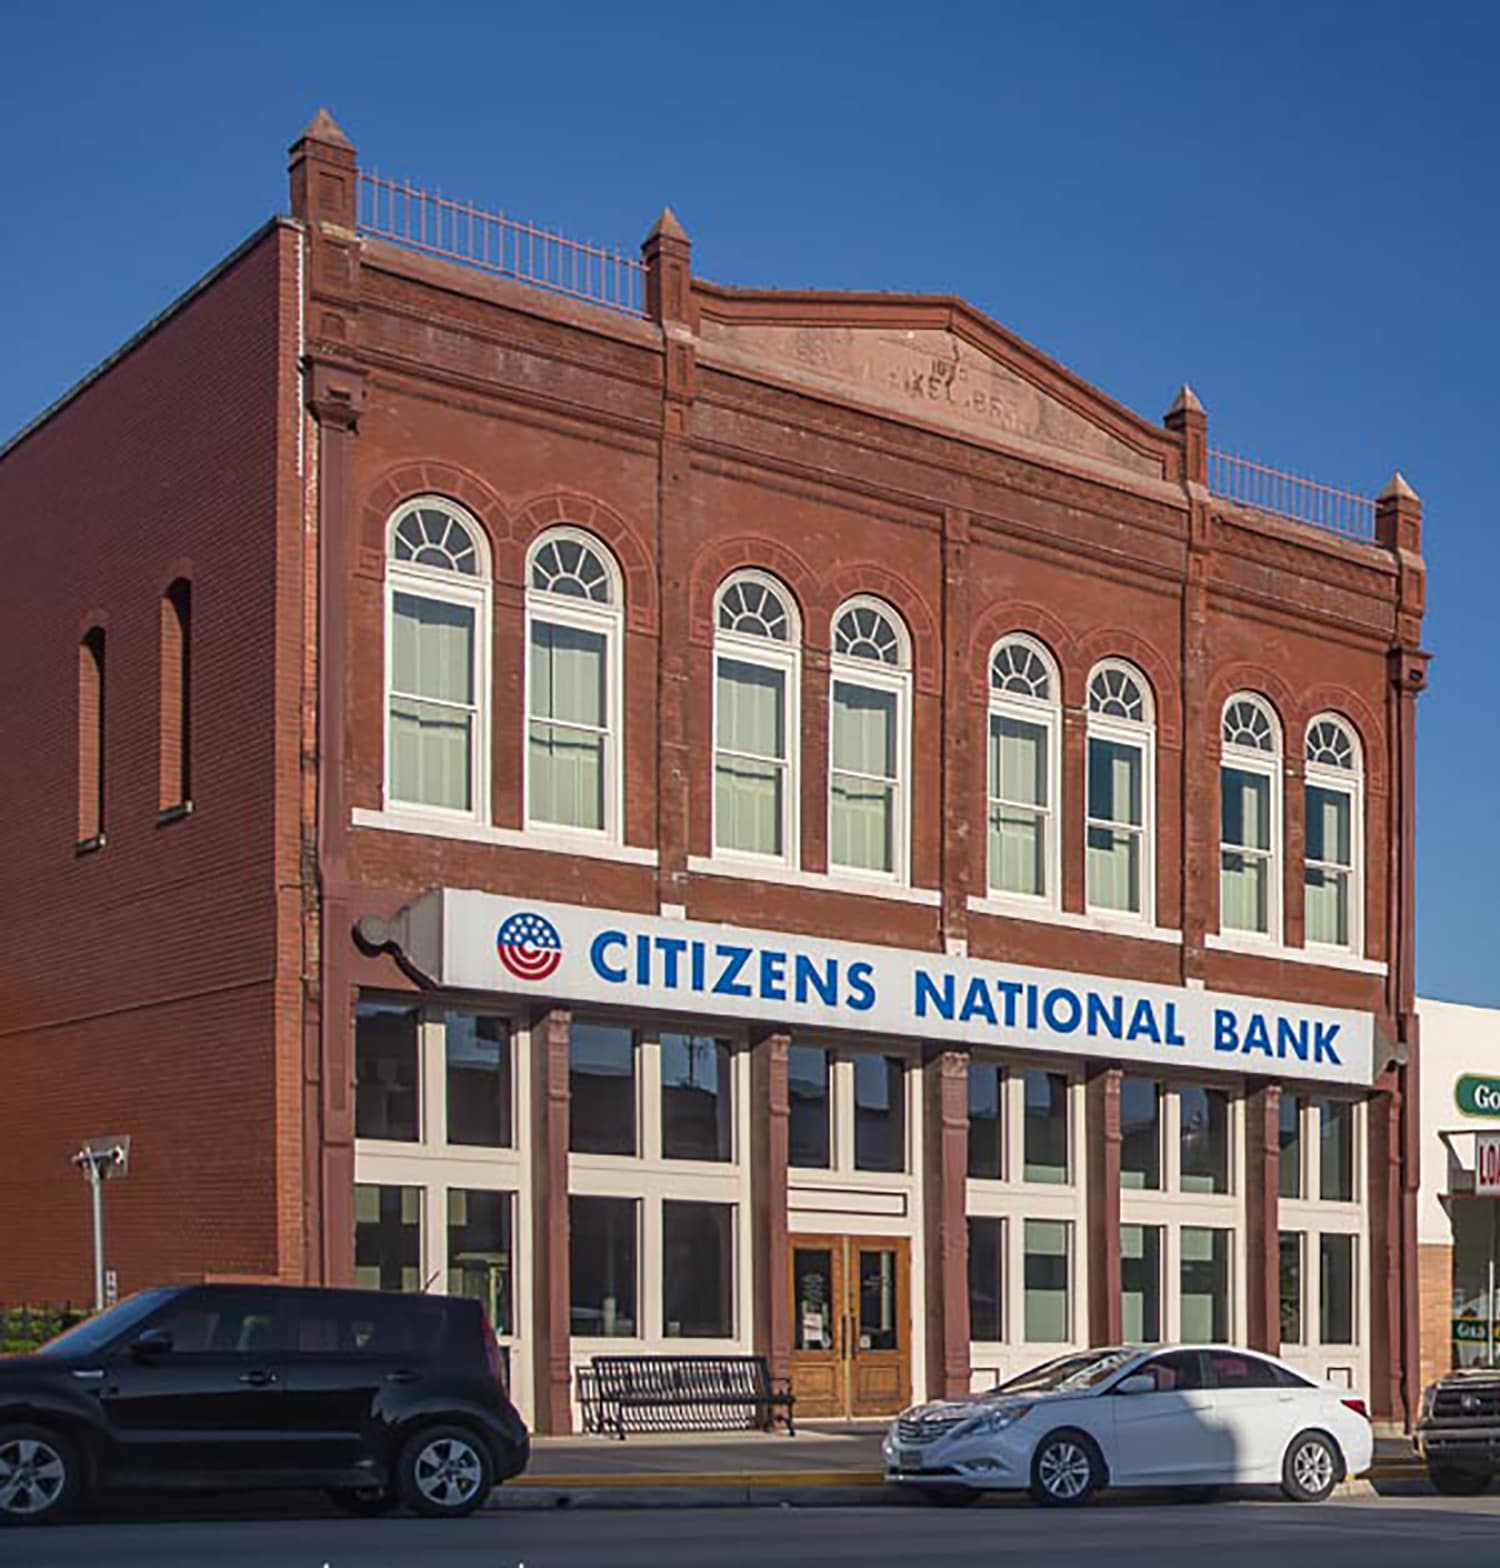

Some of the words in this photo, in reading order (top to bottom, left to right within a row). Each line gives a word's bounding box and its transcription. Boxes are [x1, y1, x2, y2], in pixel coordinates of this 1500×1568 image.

[590, 929, 877, 1021] CITIZENS
[914, 970, 1185, 1047] NATIONAL
[1213, 1009, 1340, 1065] BANK
